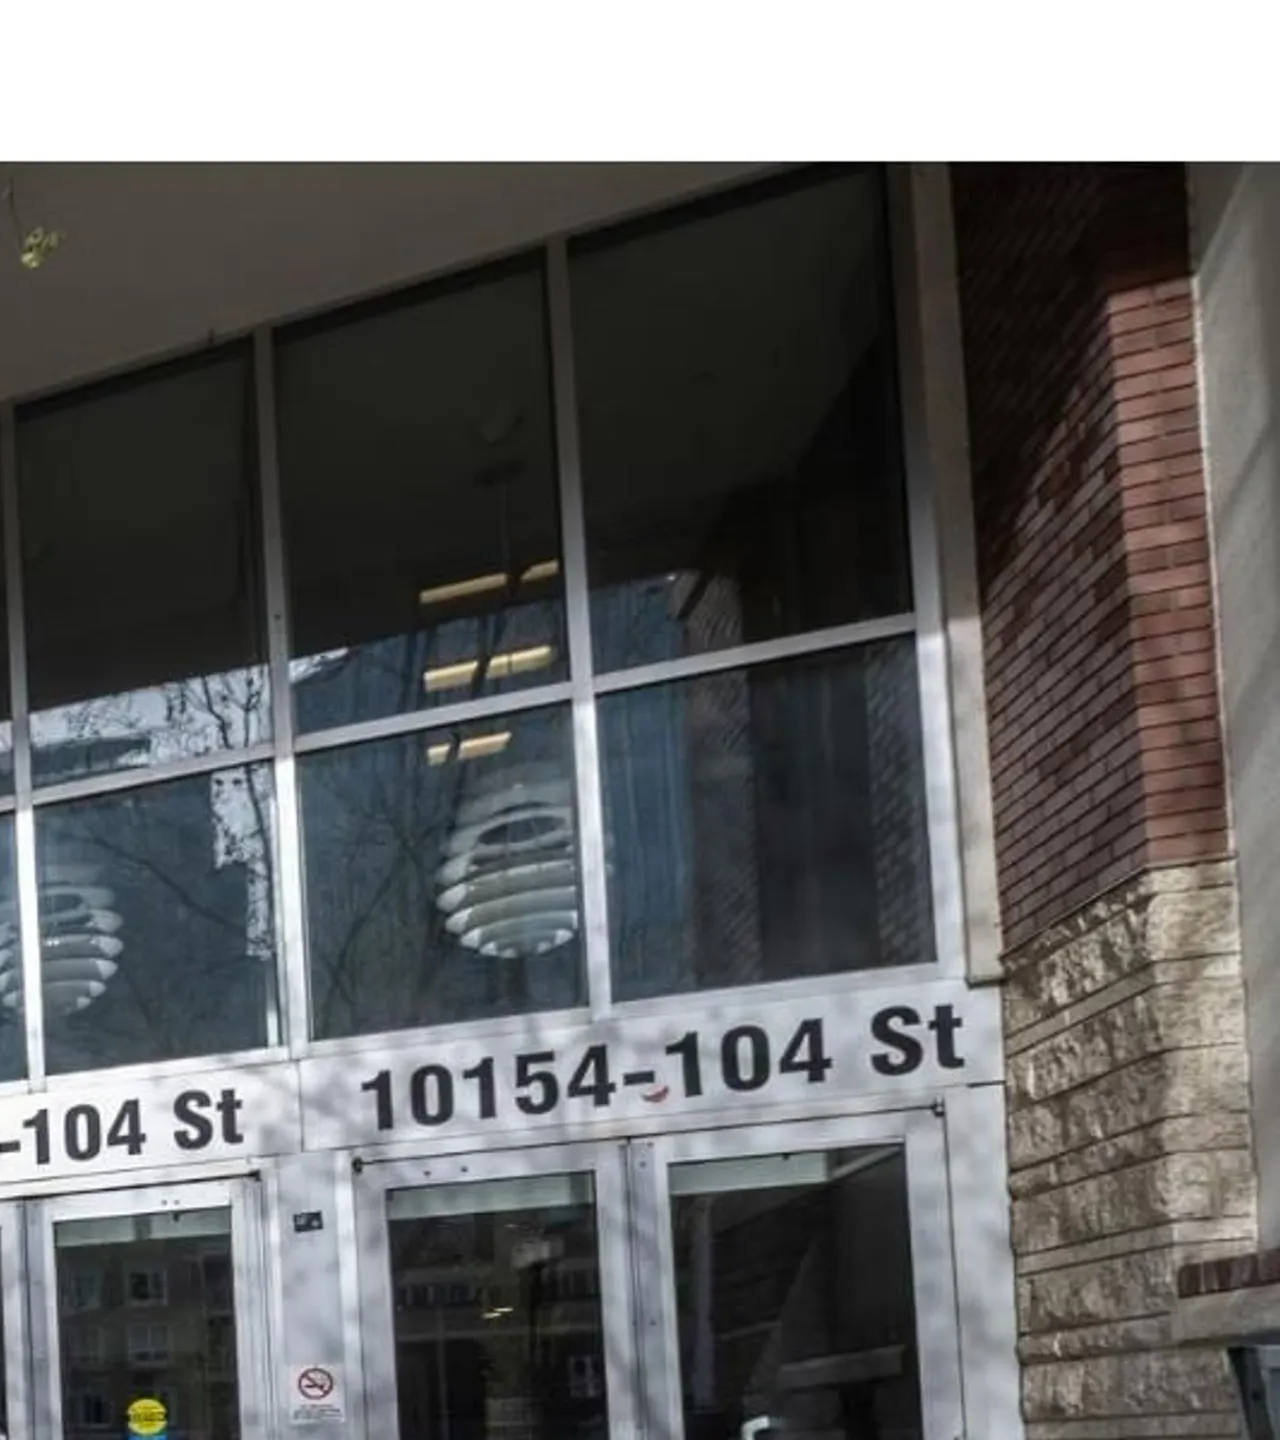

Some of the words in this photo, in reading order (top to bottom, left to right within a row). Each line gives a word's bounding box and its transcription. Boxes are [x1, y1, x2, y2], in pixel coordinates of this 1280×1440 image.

[361, 1017, 833, 1131] 10154-104
[870, 1004, 965, 1077] St
[173, 1089, 244, 1150] St
